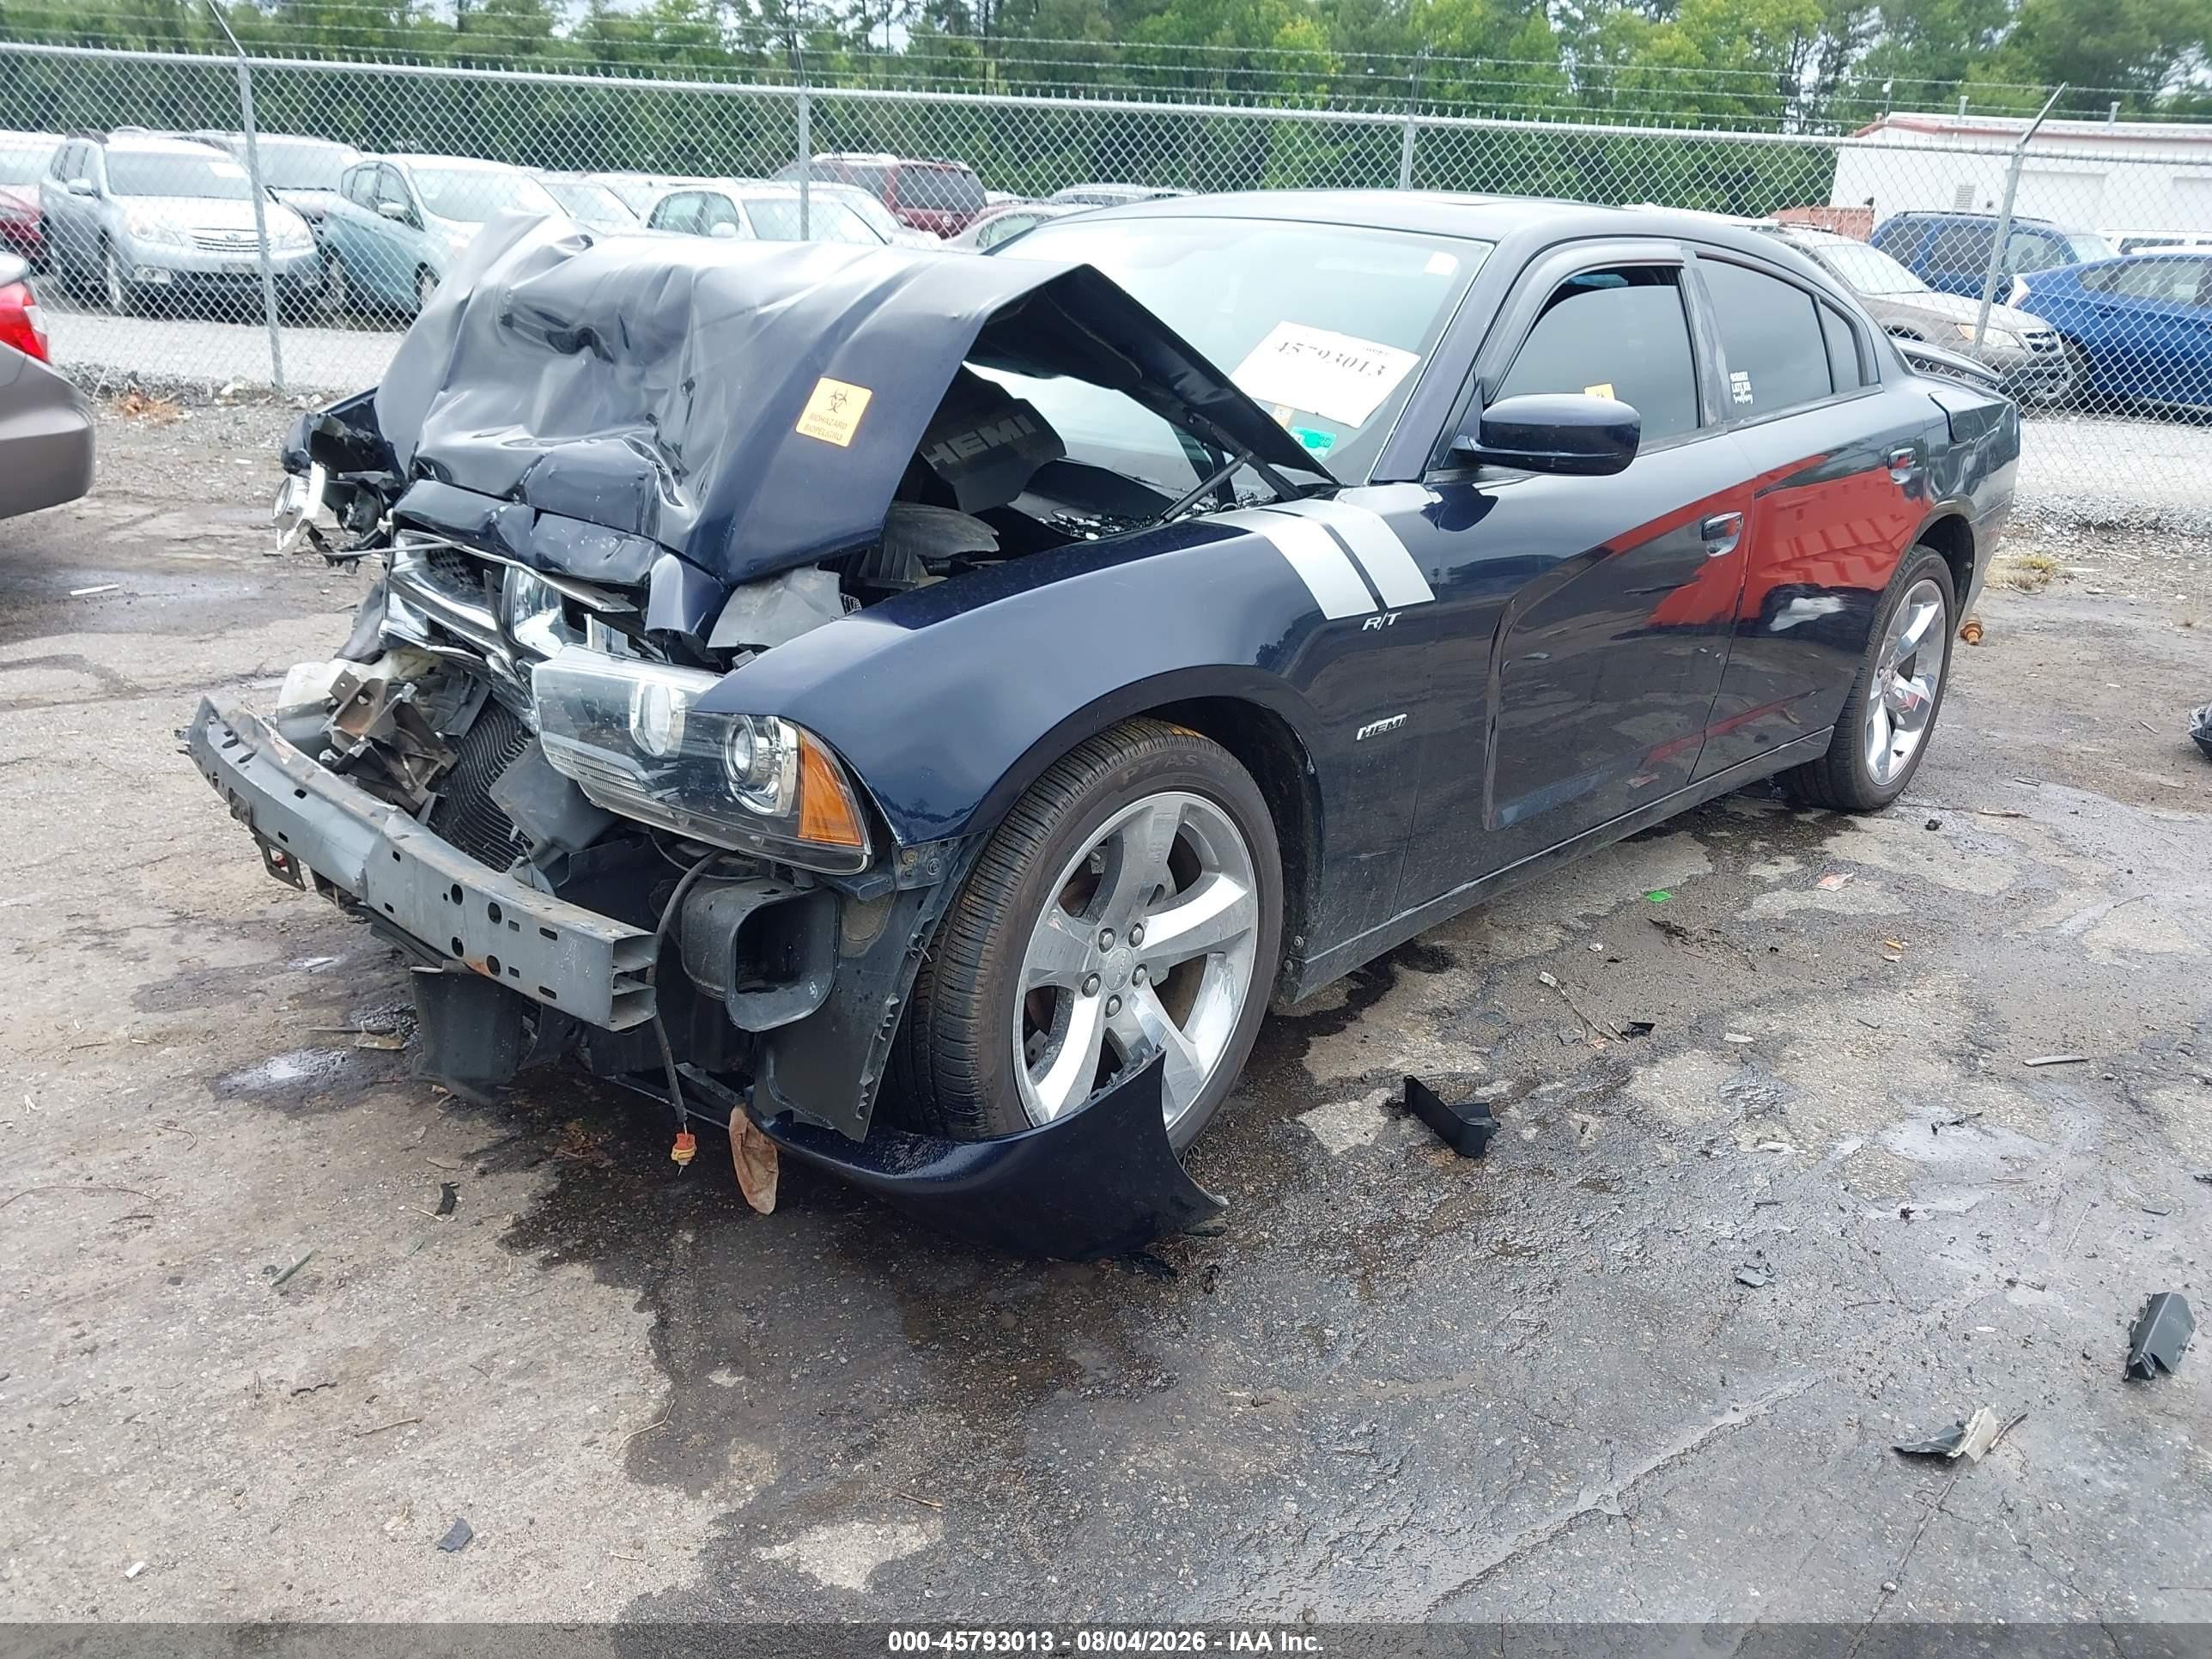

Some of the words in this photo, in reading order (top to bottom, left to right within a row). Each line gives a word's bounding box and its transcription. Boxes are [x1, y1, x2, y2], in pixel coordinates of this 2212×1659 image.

[809, 413, 848, 430] BIOHAZARD
[921, 414, 1036, 470] HEMI
[1362, 611, 1402, 631] R/T
[1356, 714, 1408, 741] HEMI
